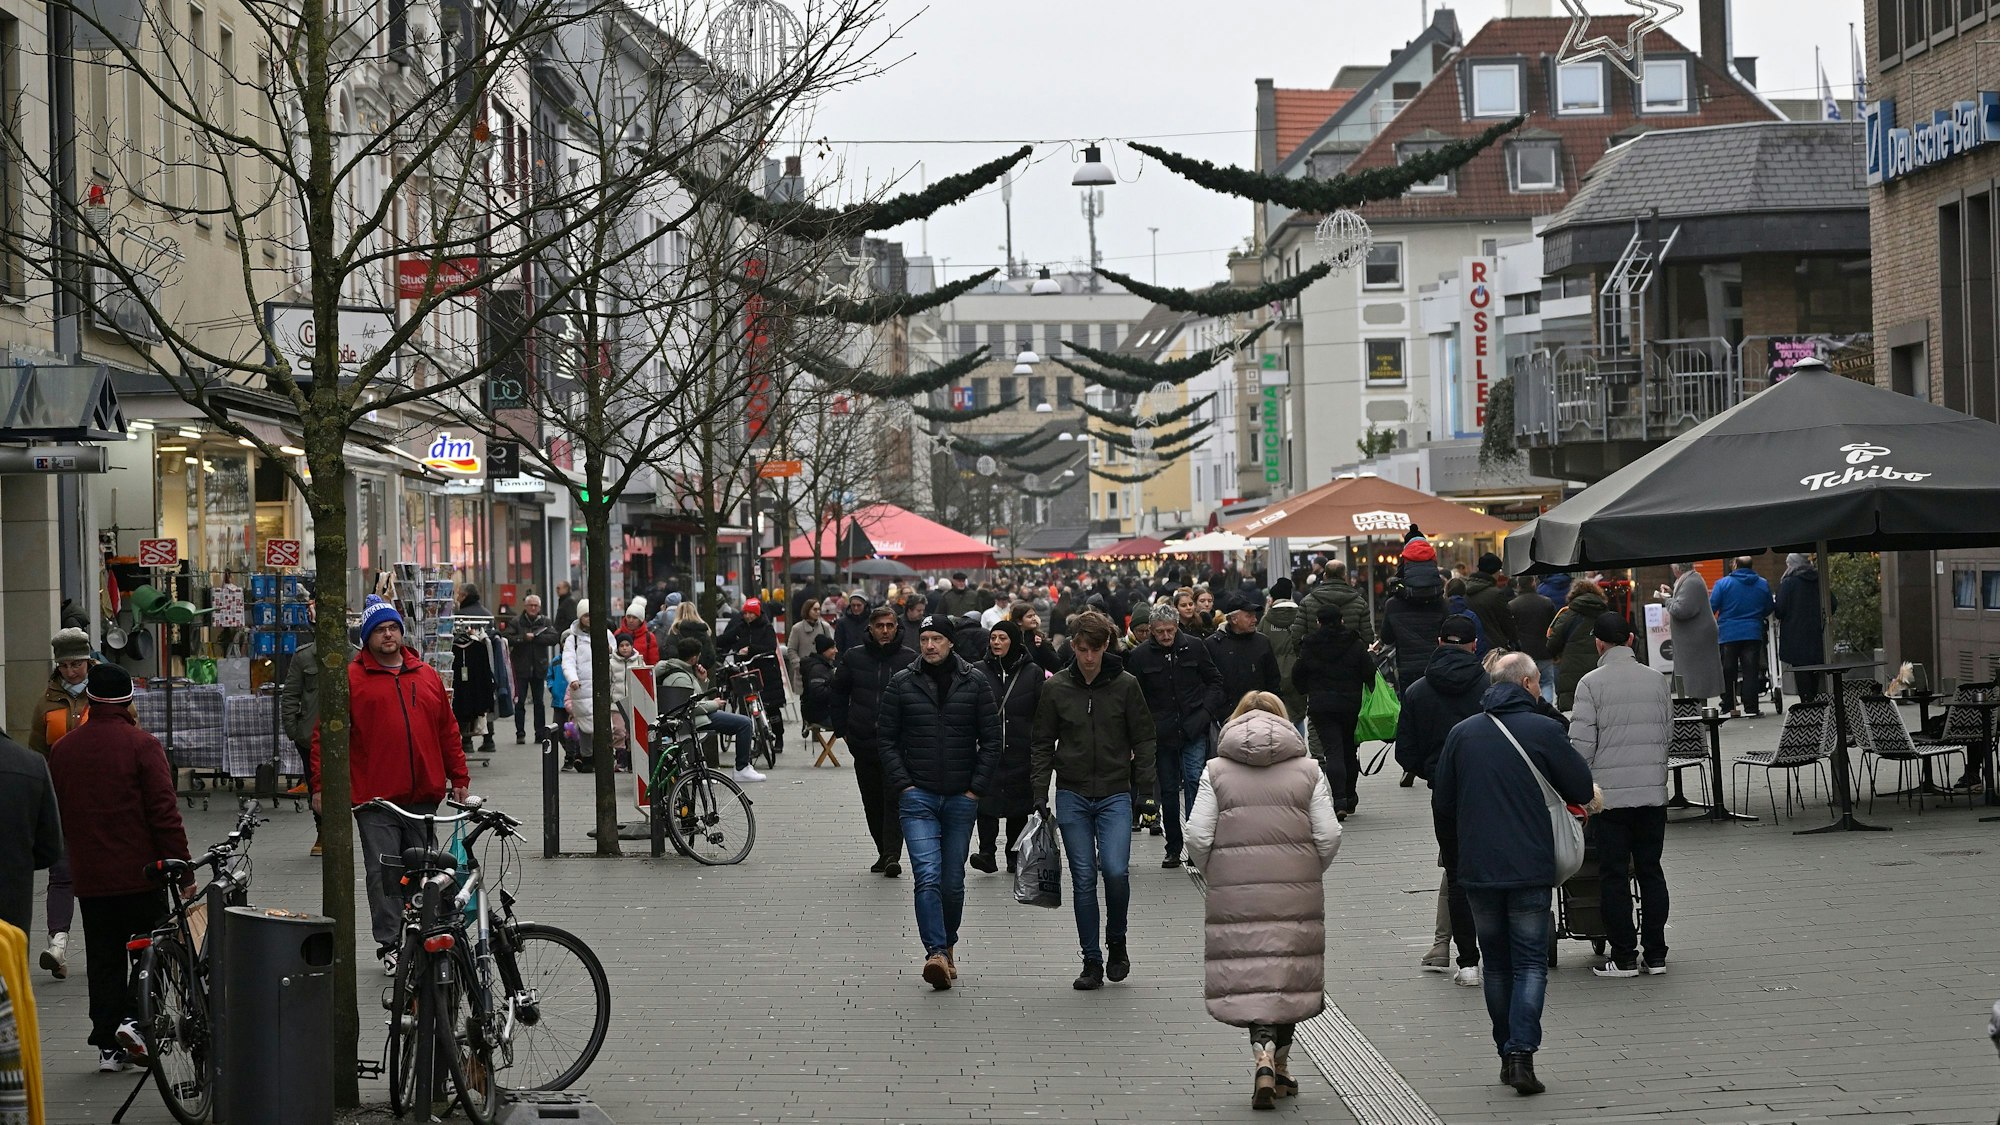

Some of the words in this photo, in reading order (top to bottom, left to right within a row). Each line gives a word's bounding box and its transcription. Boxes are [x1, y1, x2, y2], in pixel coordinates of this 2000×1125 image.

[1888, 109, 1949, 178] Deutsche
[1953, 91, 1989, 155] Bank
[1470, 262, 1490, 427] RÖSELER
[1262, 353, 1279, 483] DEICHMAN
[431, 435, 471, 459] dm
[1800, 465, 1932, 491] Tchibo
[1355, 512, 1410, 524] back
[1355, 521, 1412, 531] WERK
